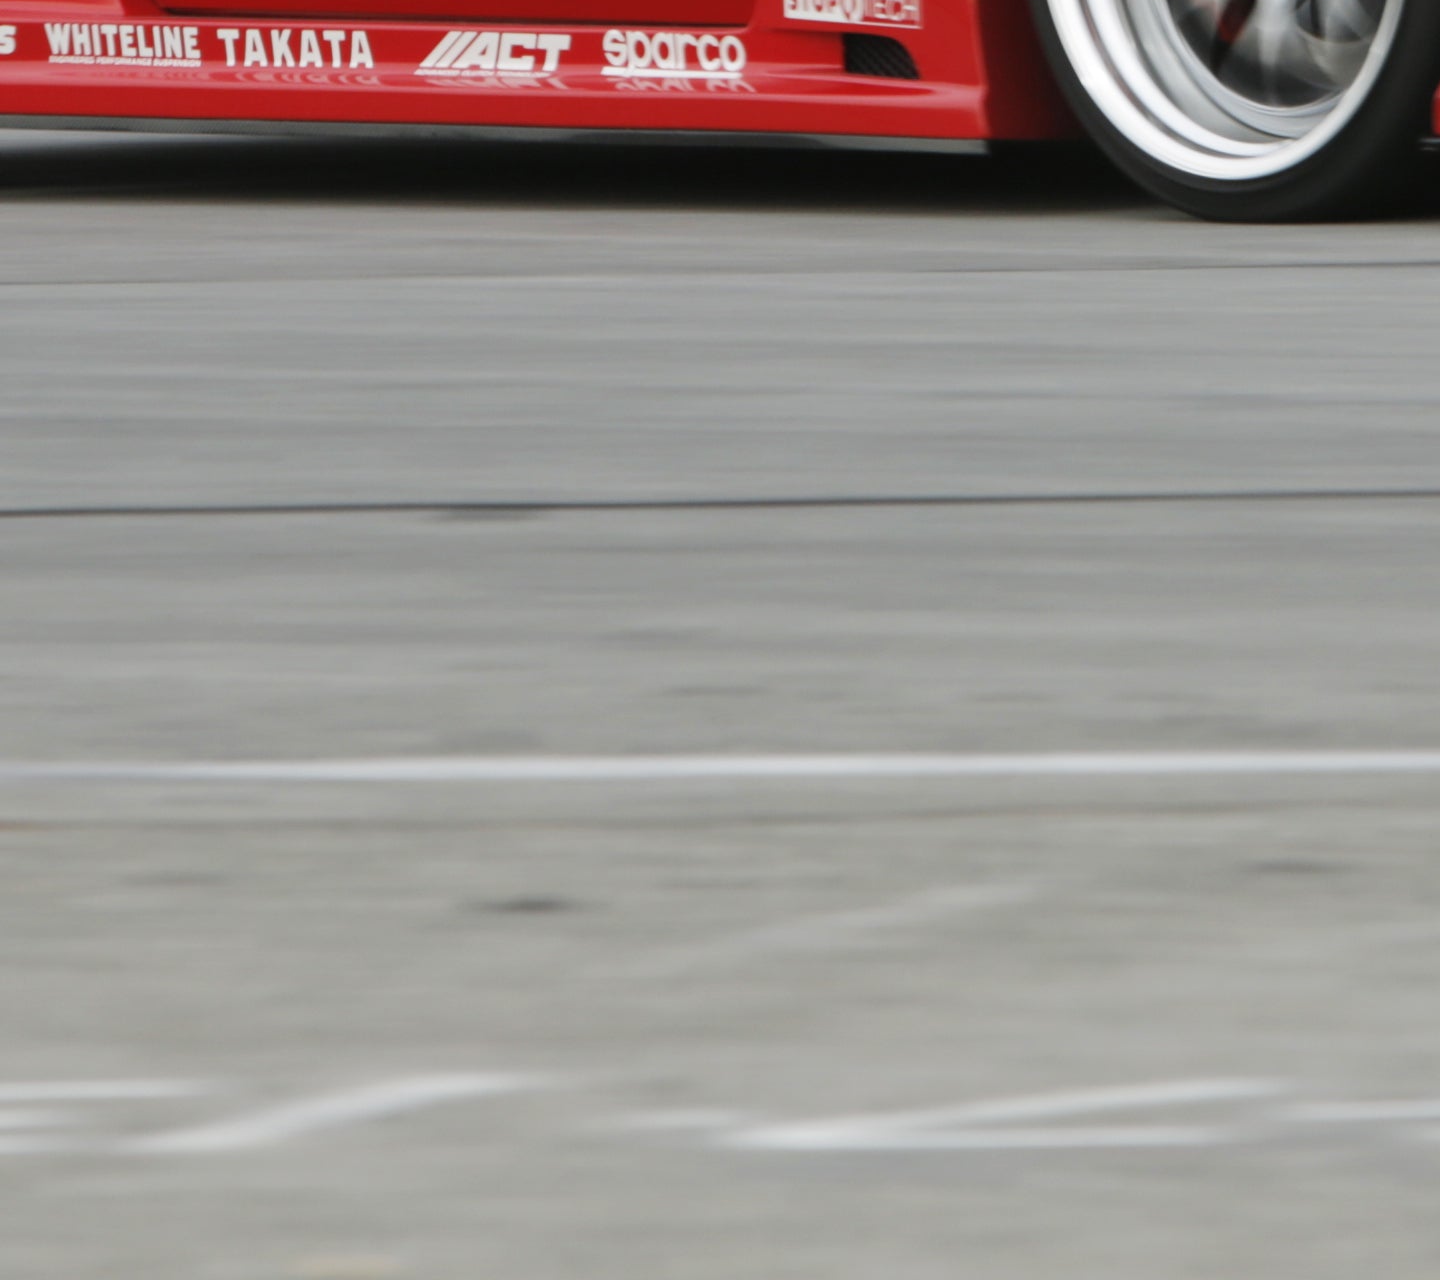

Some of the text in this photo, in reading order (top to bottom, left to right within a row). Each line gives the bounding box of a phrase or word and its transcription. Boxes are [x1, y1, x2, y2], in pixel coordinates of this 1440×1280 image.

[44, 23, 201, 59] WHITELINE
[216, 28, 374, 69] TAKATA
[602, 29, 747, 77] sparco
